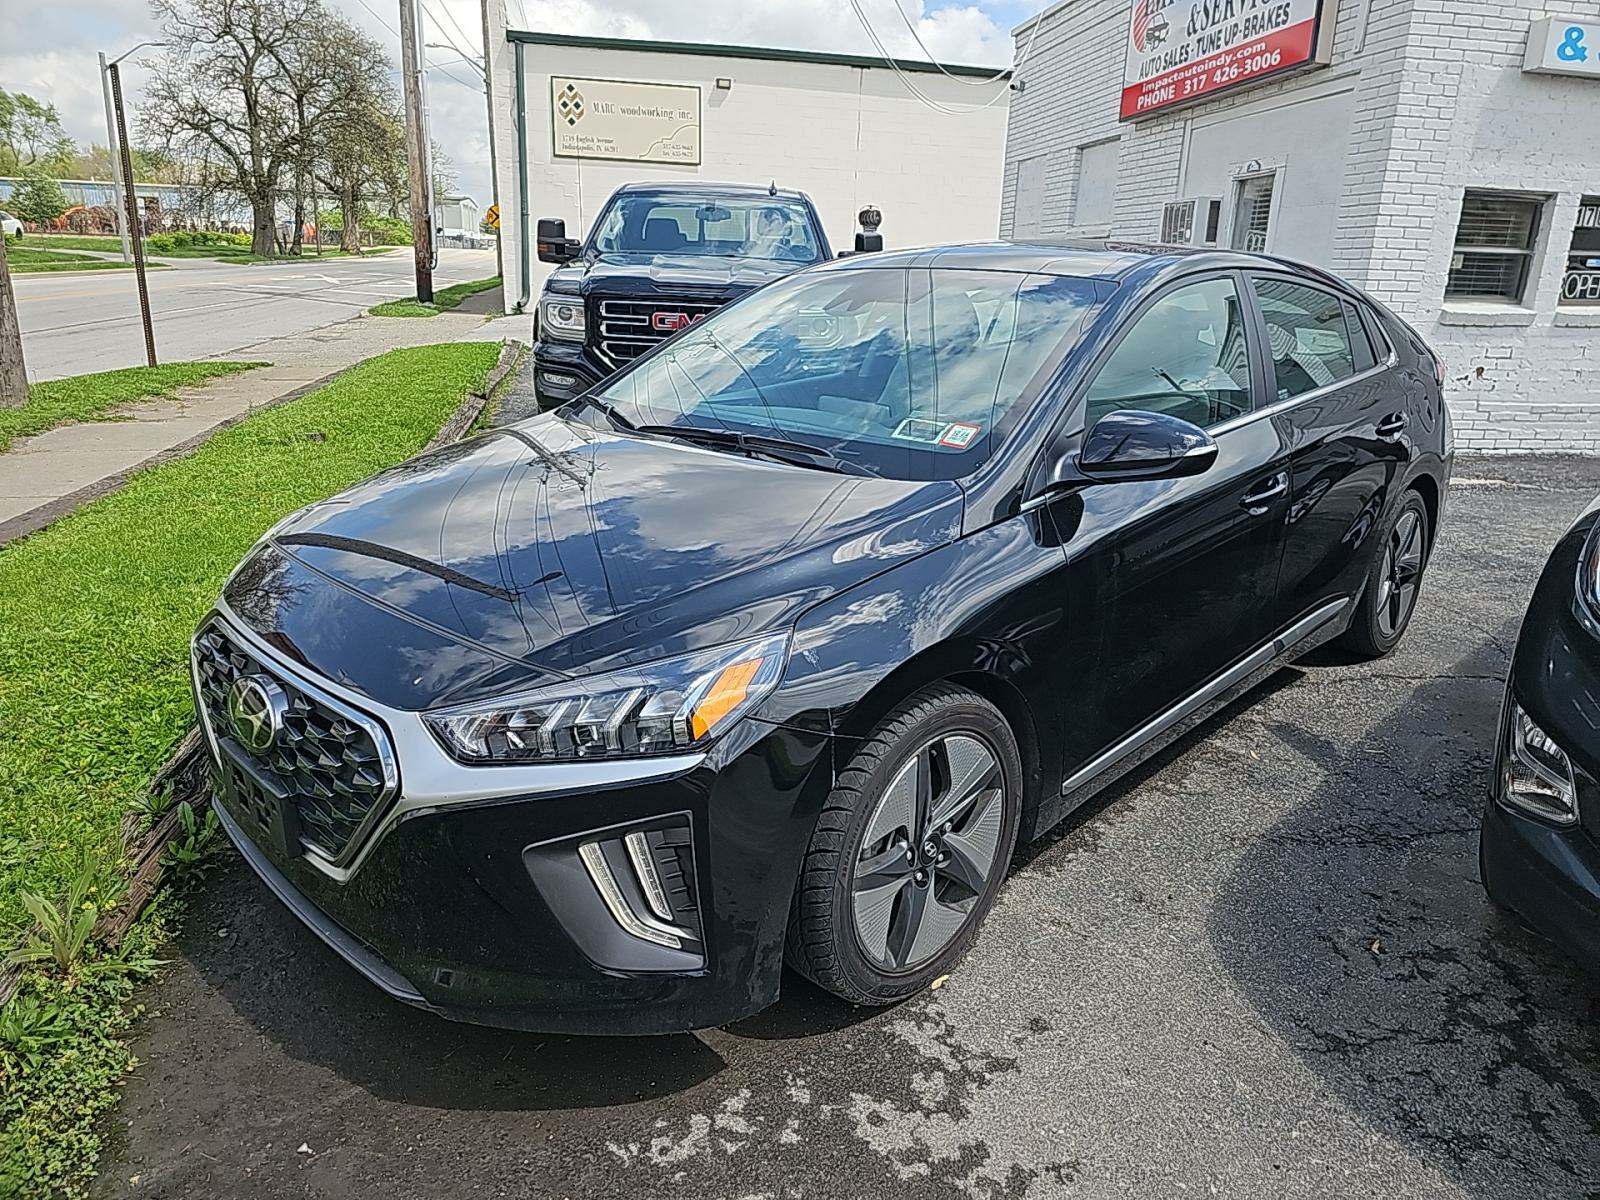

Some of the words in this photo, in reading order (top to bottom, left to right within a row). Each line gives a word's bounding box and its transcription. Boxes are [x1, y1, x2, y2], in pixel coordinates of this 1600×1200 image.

[1557, 26, 1588, 63] &
[1136, 85, 1176, 111] PHONE
[1182, 74, 1208, 95] 317
[1212, 48, 1282, 85] 426-3006
[1138, 54, 1161, 80] AUTO
[1142, 41, 1267, 93] impactautoindy.com
[593, 101, 616, 113] MARC
[620, 103, 674, 121] woodworking
[678, 107, 693, 119] inc.
[1565, 274, 1600, 298] OPE
